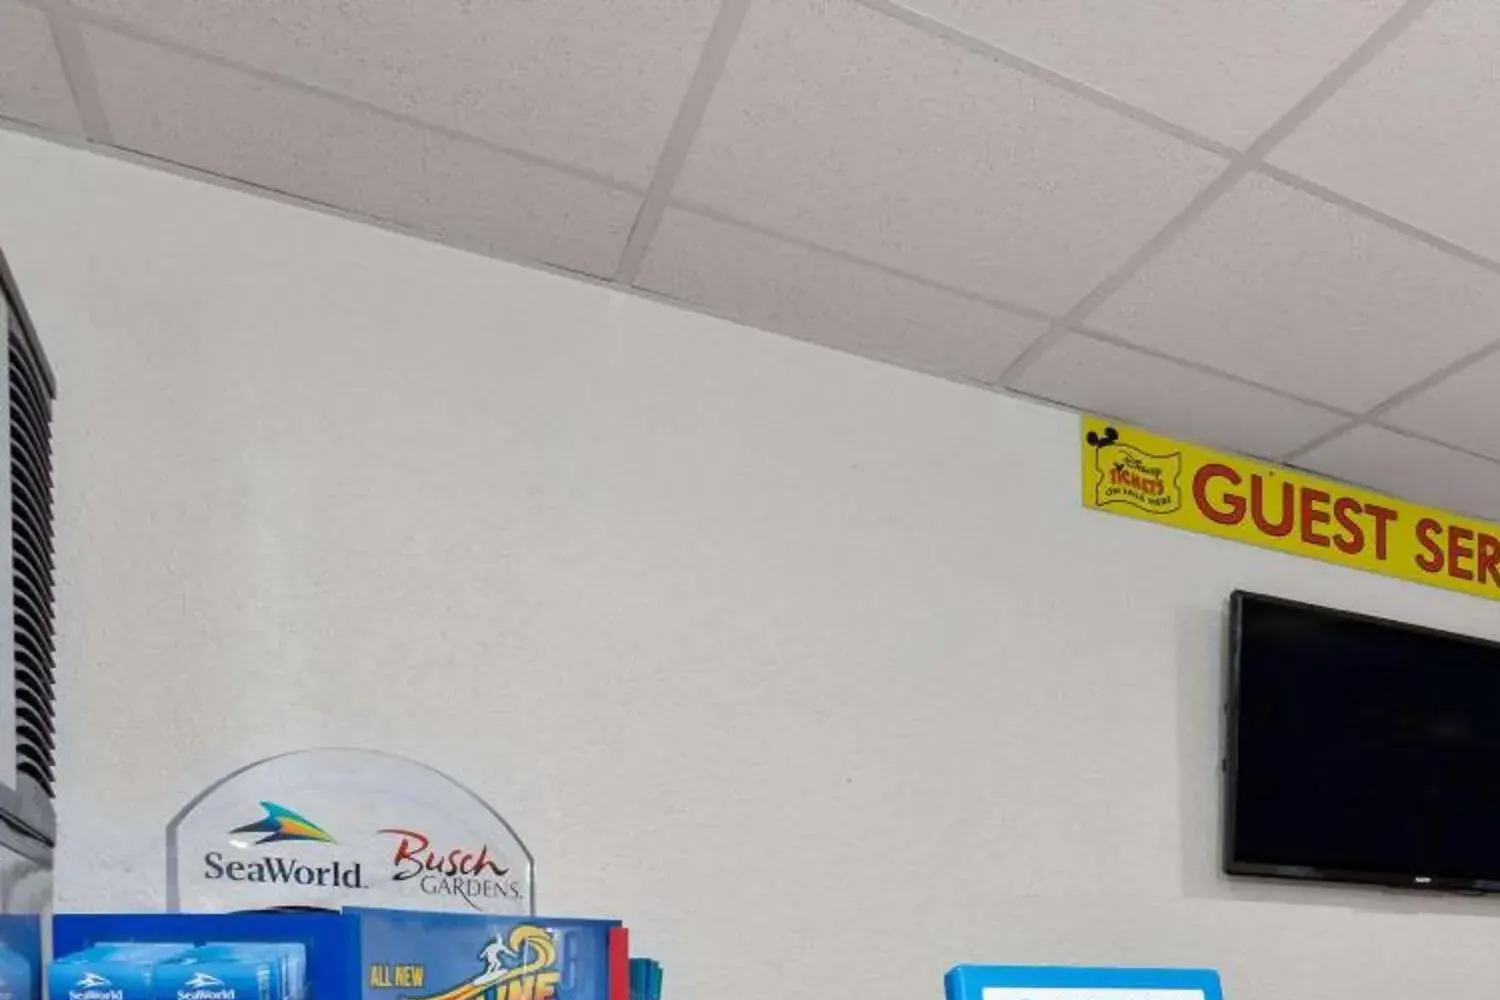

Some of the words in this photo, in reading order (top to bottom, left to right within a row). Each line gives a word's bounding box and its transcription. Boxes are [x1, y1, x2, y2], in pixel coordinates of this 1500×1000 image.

[1193, 463, 1397, 560] GUEST
[203, 851, 362, 889] SeaWorld
[378, 829, 509, 881] Busch
[177, 989, 236, 1000] SeaWorld
[370, 965, 391, 988] ALL
[394, 965, 425, 988] NEW
